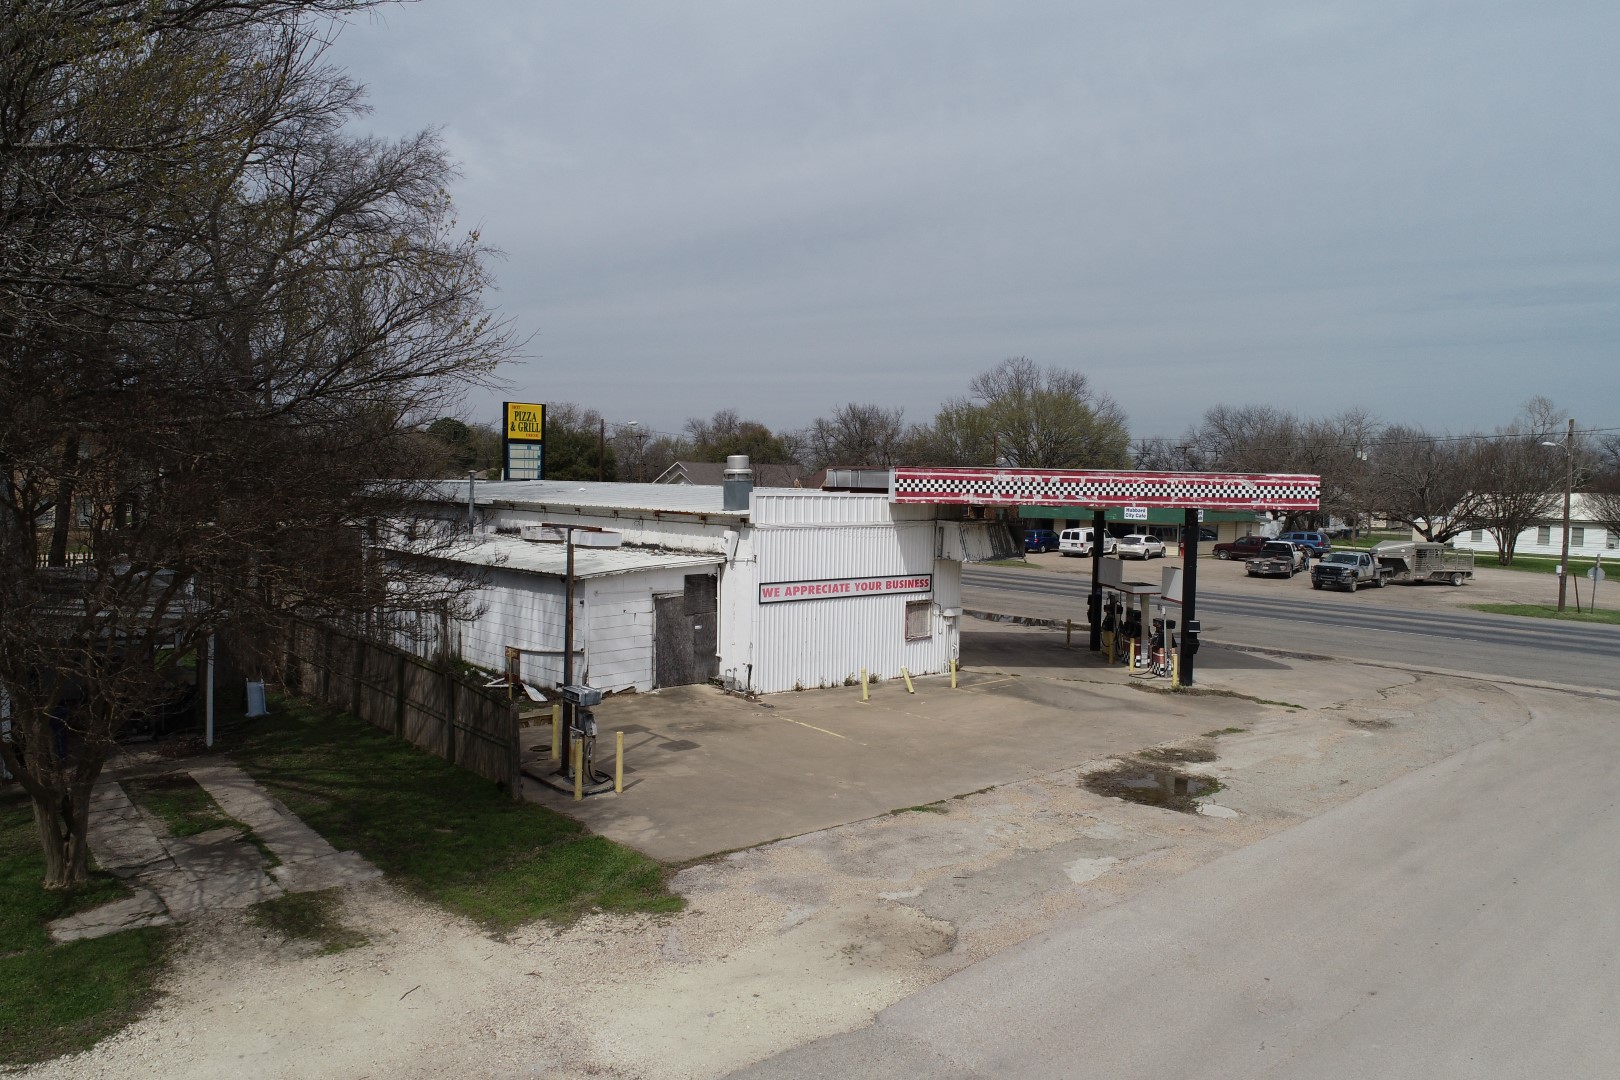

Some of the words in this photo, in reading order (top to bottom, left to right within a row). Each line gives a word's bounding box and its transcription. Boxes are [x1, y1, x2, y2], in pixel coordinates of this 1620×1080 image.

[514, 411, 537, 422] PIZZA
[510, 421, 516, 432] &
[518, 422, 540, 432] GRILL
[762, 588, 780, 598] WE
[784, 583, 850, 596] APPRECIATE
[854, 580, 882, 592] YOUR
[886, 578, 929, 590] BUSINESS
